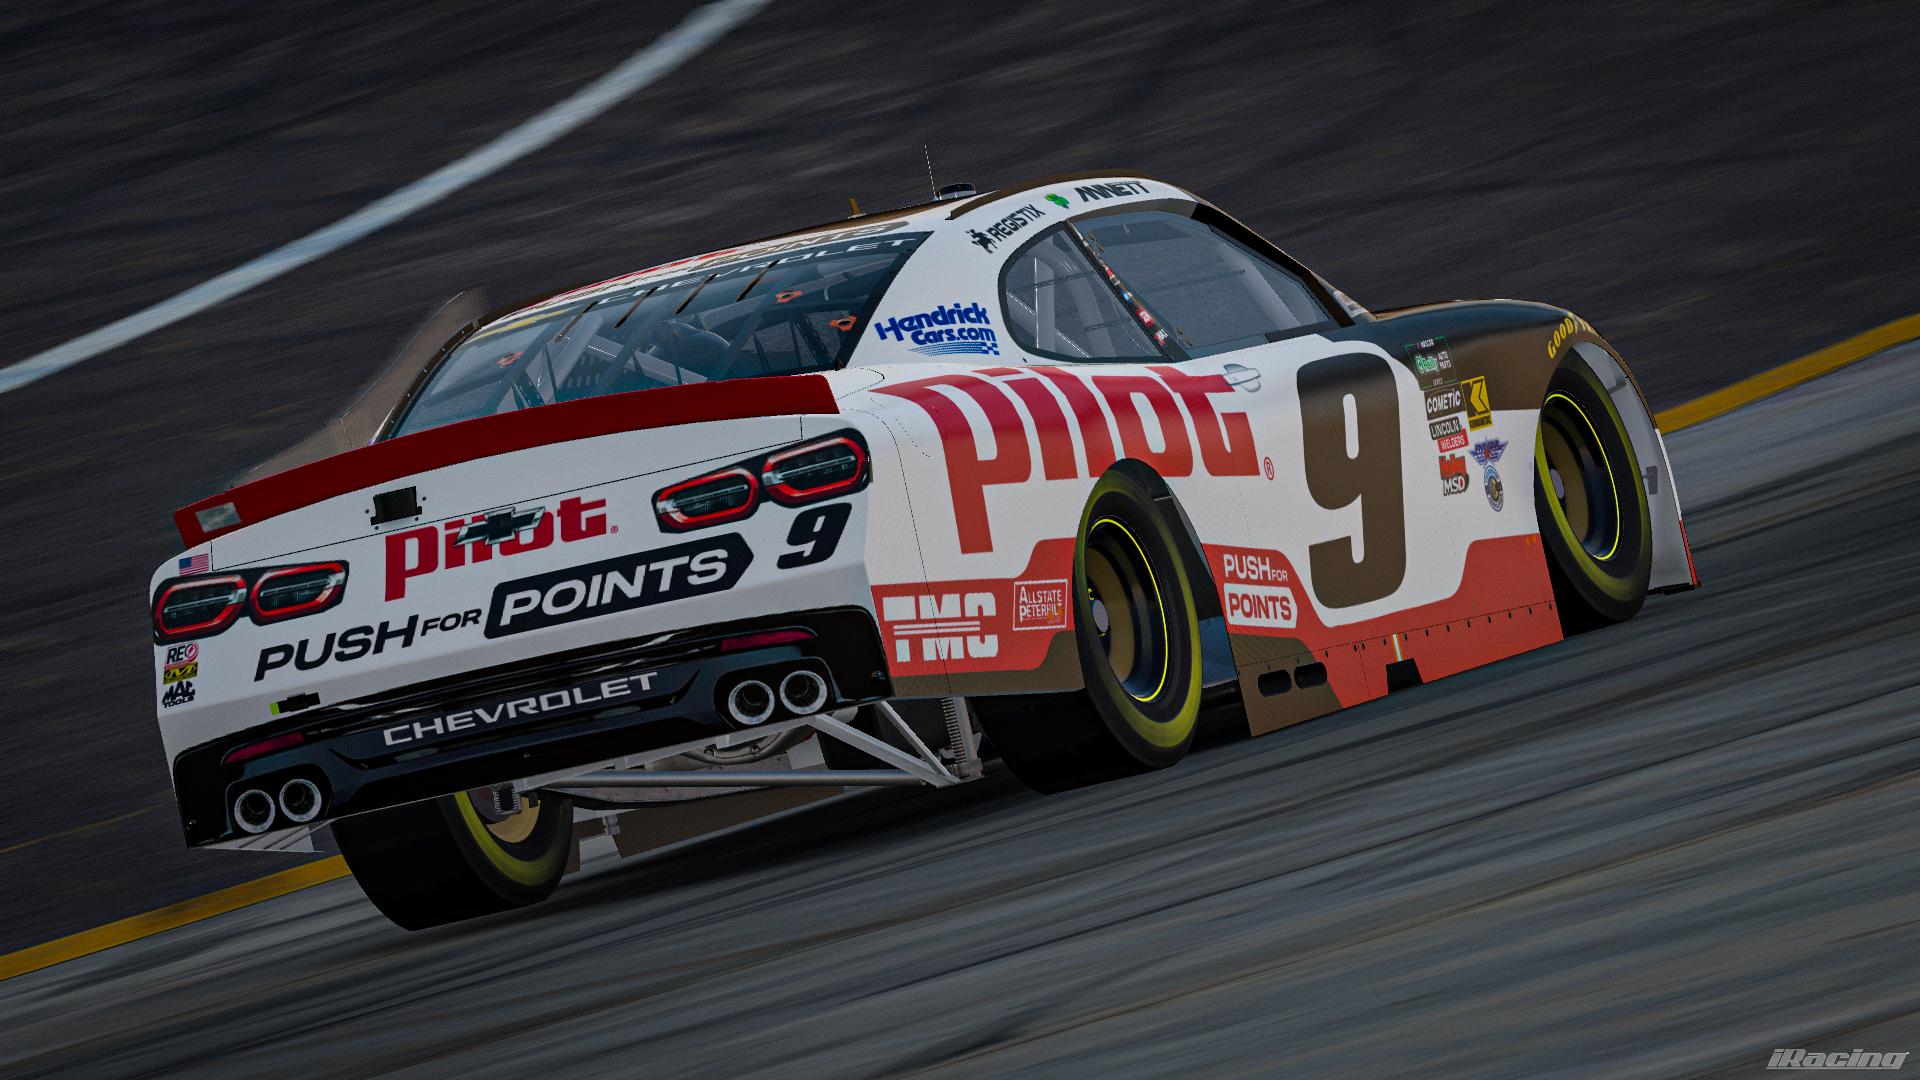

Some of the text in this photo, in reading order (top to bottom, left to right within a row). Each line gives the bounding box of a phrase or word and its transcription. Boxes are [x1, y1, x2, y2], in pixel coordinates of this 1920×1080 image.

[1074, 180, 1150, 202] ANNETT
[986, 204, 1046, 241] REGISTIX
[874, 303, 990, 342] Hendrick
[1547, 312, 1601, 359] GOODY
[1426, 388, 1461, 414] COMETIC
[1430, 420, 1459, 438] LINCOLN
[1440, 435, 1465, 451] WELDERS
[1296, 352, 1407, 609] 9
[1443, 475, 1467, 496] MSD
[777, 502, 852, 570] 9
[1223, 554, 1289, 582] PUSH FOR
[254, 549, 729, 682] PUSH FOR POINTS
[1229, 593, 1293, 622] POINTS
[882, 592, 999, 663] TMC
[162, 695, 195, 709] TOOLS
[384, 672, 659, 747] CHEVROLET
